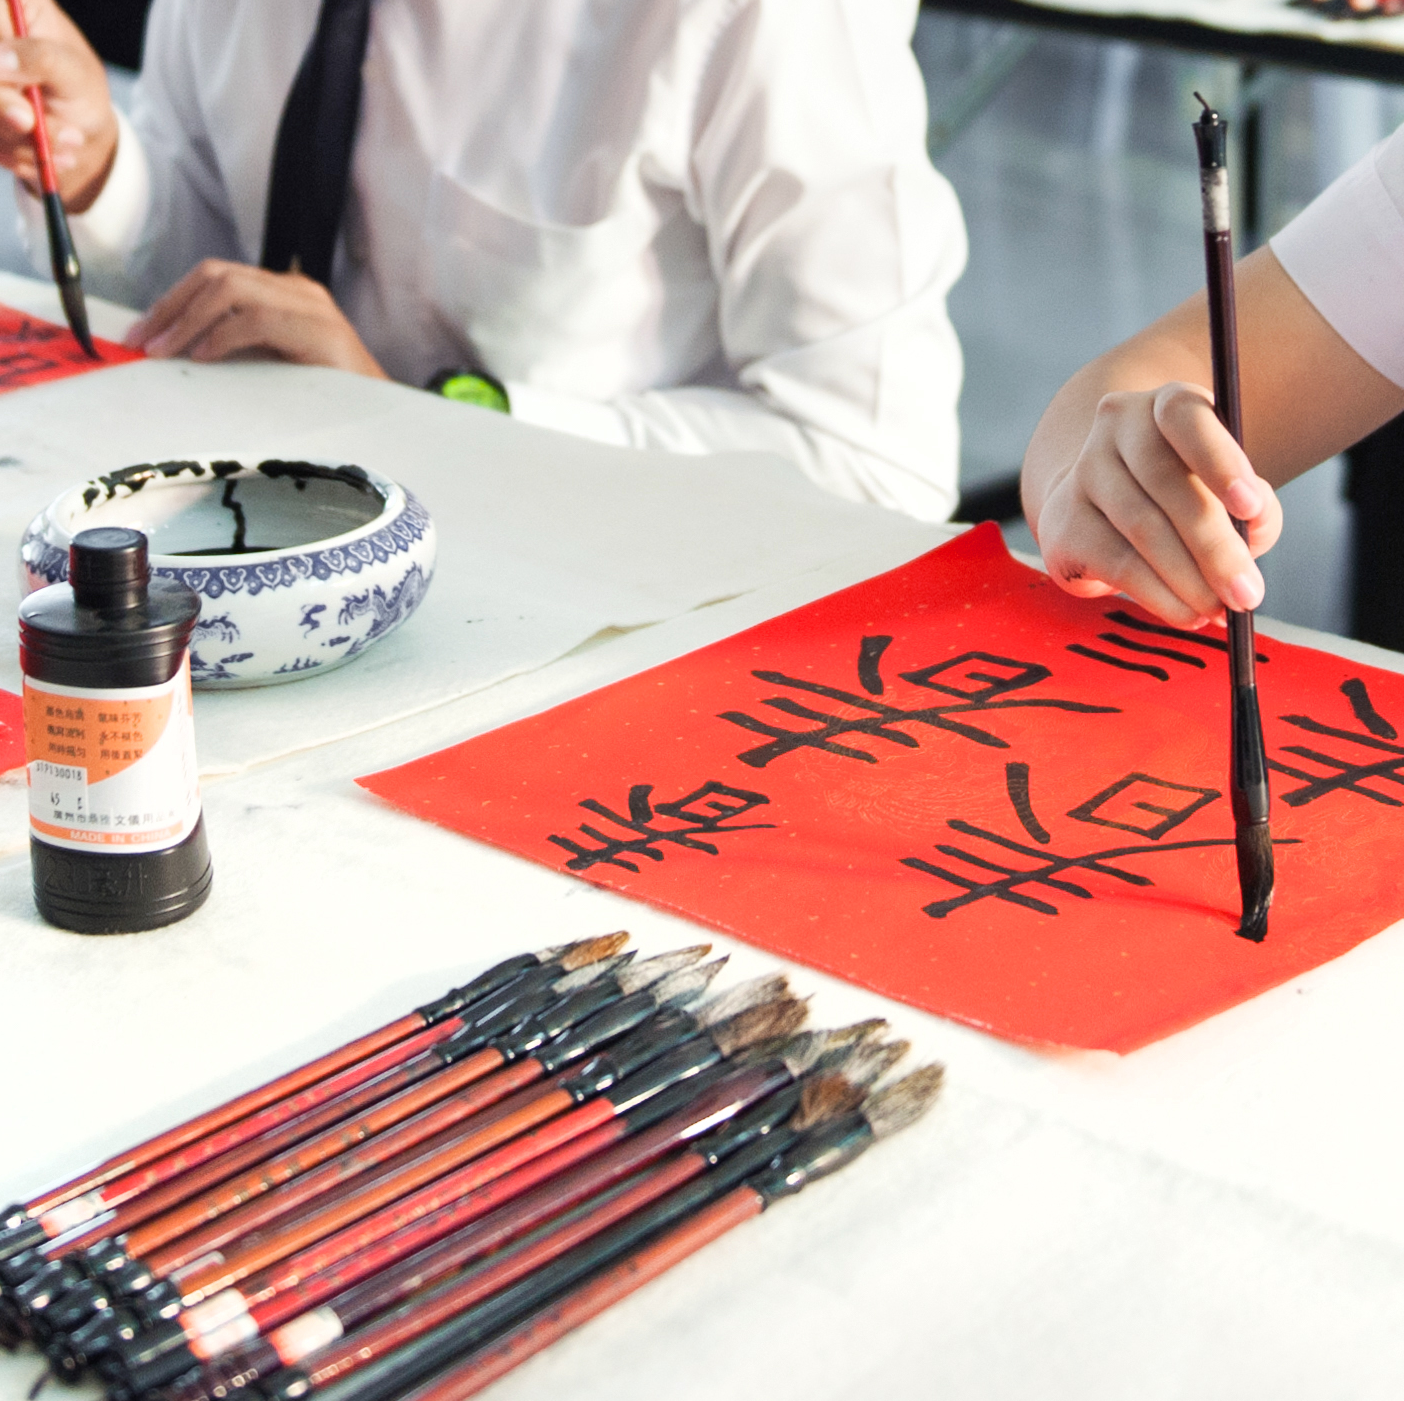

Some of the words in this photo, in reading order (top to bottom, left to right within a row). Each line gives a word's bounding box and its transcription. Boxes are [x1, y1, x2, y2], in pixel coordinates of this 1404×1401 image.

[717, 635, 1124, 768] 春
[70, 829, 105, 843] MADE
[111, 834, 125, 843] IN
[131, 829, 172, 843] CHINA
[549, 782, 777, 871] 春
[897, 762, 1302, 919] 春
